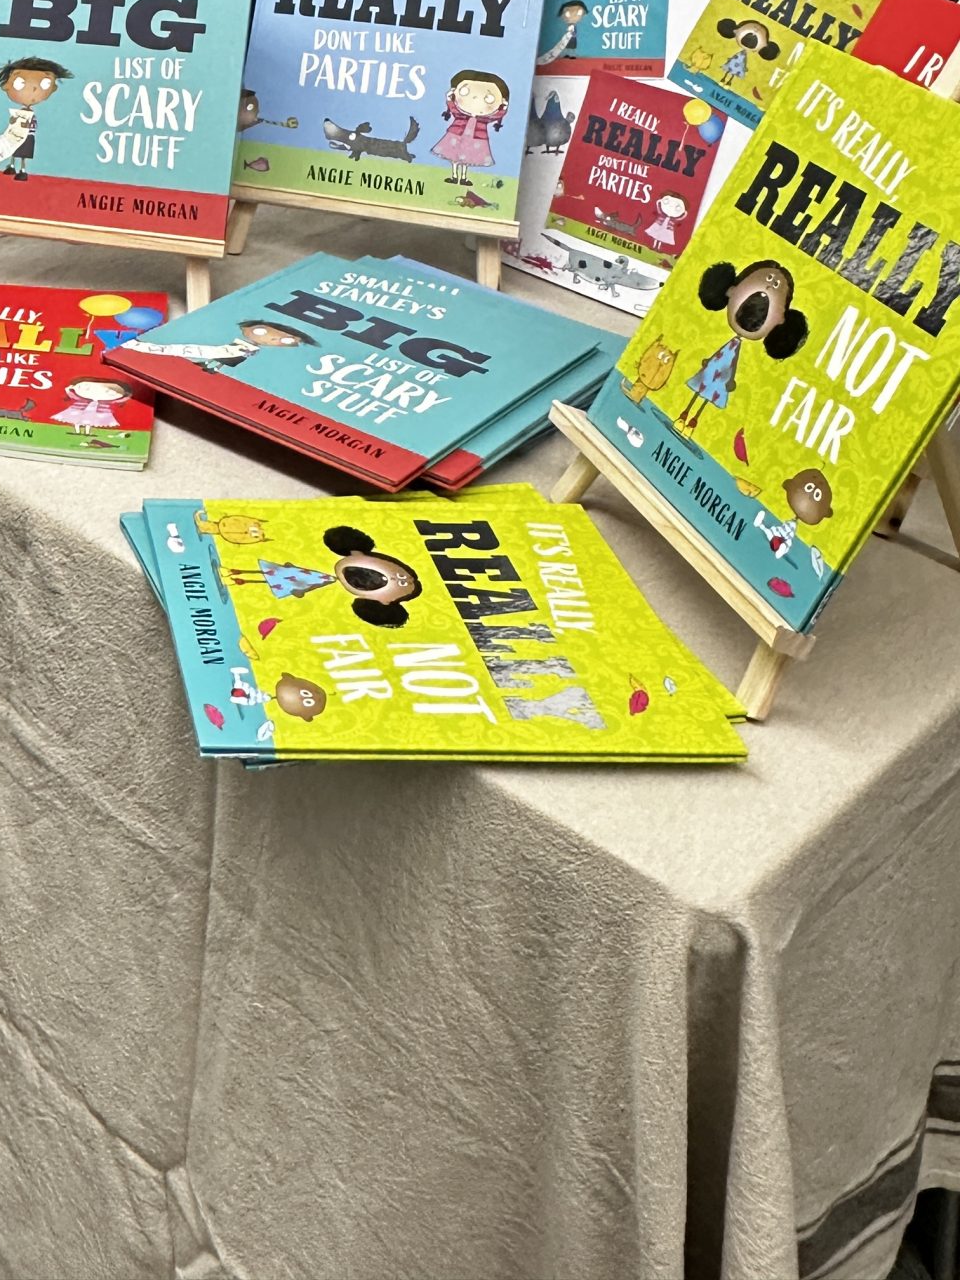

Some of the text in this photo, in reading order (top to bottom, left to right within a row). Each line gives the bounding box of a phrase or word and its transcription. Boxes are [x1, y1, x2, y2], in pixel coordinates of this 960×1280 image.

[591, 3, 649, 28] SCARY
[314, 29, 416, 54] DON'T LIKE
[602, 31, 643, 50] STUFF
[903, 45, 926, 73] I
[114, 57, 186, 80] LIST OF
[298, 52, 426, 101] PARTIES
[80, 81, 203, 132] SCARY
[609, 98, 661, 135] I REALLY,
[96, 132, 185, 169] STUFF
[582, 115, 706, 178] REALLY
[796, 79, 917, 203] IT'S REALLY,
[307, 164, 425, 196] ANGIE MORGAN
[588, 166, 653, 204] PARTIES
[628, 160, 650, 178] LIKE
[77, 193, 199, 220] ANGIE MORGAN
[734, 141, 960, 338] REALLY
[314, 280, 447, 320] STANLEY'S
[339, 271, 414, 298] SMALL
[264, 289, 492, 378] BIG
[305, 354, 452, 414] SCARY
[364, 353, 450, 387] LIST OF
[814, 306, 932, 416] NOT
[300, 380, 409, 425] STUFF
[769, 376, 857, 465] FAIR
[252, 398, 387, 460] ANGIE MORGAN
[651, 439, 748, 542] ANGIE MORGAN
[525, 520, 596, 634] IT'S REALLY,
[177, 562, 227, 666] ANGIE MORGAN
[413, 520, 608, 730] REALLY
[309, 632, 394, 705] FAIR
[386, 643, 498, 725] NOT
